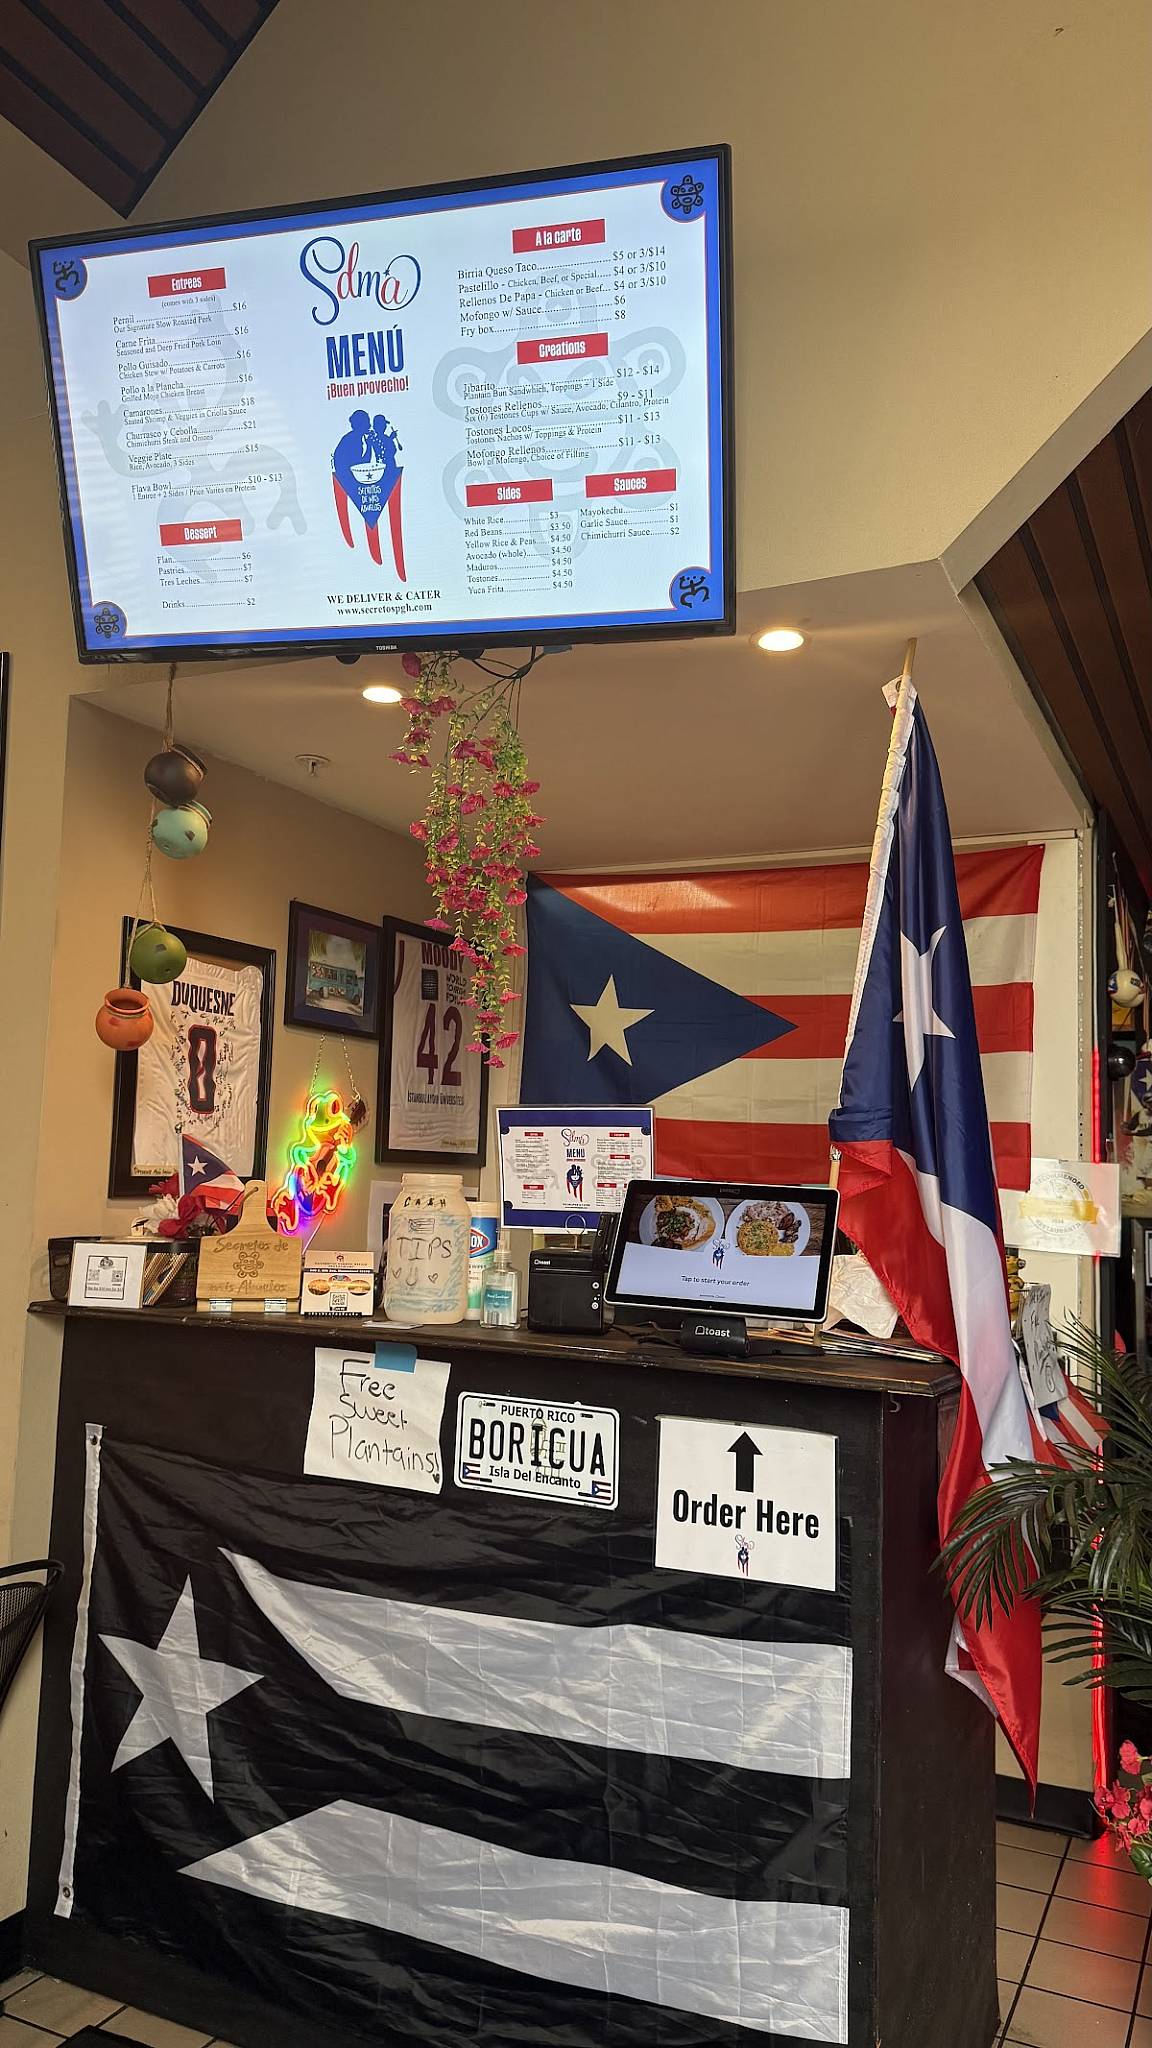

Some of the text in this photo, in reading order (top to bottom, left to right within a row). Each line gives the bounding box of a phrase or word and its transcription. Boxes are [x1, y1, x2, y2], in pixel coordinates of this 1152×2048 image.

[536, 228, 581, 246] A la carte
[458, 268, 483, 279] Birria
[485, 265, 513, 277] Queso
[516, 262, 537, 272] Taco
[613, 251, 624, 261] $5
[639, 246, 665, 258] 3/$14
[172, 276, 202, 291] Entrees
[458, 281, 498, 294] Pastelillo
[508, 277, 539, 288] Chicken,
[541, 275, 559, 285] Beef,
[571, 270, 597, 281] Special
[614, 266, 624, 276] $4
[640, 261, 666, 273] 3/$10
[459, 297, 497, 308] Rellenos
[499, 295, 512, 303] De
[514, 292, 536, 303] Papa
[545, 287, 574, 299] Chicken
[614, 281, 625, 290] $4
[640, 275, 667, 287] 3/$10
[113, 302, 247, 325] Pernil $16
[460, 295, 626, 322] Mofongo w/ Sauce $6
[461, 310, 626, 337] Fry box $8
[116, 326, 249, 349] Carne Frita $16
[326, 324, 404, 379] MENÚ
[539, 341, 585, 358] Creations
[119, 351, 251, 372] Pollo Guisado $16
[617, 366, 659, 378] $12 $14
[121, 374, 253, 395] Pollo la Plancha $16
[327, 375, 409, 400] ¡Buen provecho!
[123, 398, 255, 418] Camarones $18
[465, 404, 502, 415] Tostones
[504, 401, 542, 410] Rellenos
[617, 392, 628, 400] $9
[126, 421, 256, 441] Churrasco Cebolla $21
[465, 412, 660, 437] Tostones Locos $11 $13
[128, 453, 152, 464] Veggie
[154, 452, 172, 460] Plate
[467, 435, 660, 459] Mofongo Rellenos $11 $13
[132, 474, 282, 494] Flava Bowl $10 $13
[497, 477, 647, 500] Sides Sauces
[464, 517, 485, 525] White
[488, 516, 503, 524] Rice
[669, 503, 678, 511] $1
[184, 526, 218, 540] Dessert
[465, 515, 678, 537] Red Beans $3.50 Garlic Sauce $1
[465, 540, 489, 549] Yellow
[493, 538, 509, 546] Rice
[551, 534, 571, 542] $4.50
[581, 529, 625, 541] Chimichurri
[628, 528, 650, 537] Sauce
[670, 527, 680, 535] $2
[157, 552, 251, 564] Flan $6
[466, 545, 571, 560] Avocado (whole) $4.50
[158, 567, 184, 575] Pastries
[467, 557, 572, 572] Maduros $4.50
[160, 578, 174, 586] Tres
[176, 577, 200, 585] Leches
[467, 569, 572, 583] Tostones $4.50
[468, 586, 486, 594] Yuca
[553, 580, 572, 589] $4.50
[162, 598, 256, 609] Drinks $2
[328, 590, 441, 604] WE DELIVER & CATER
[338, 604, 432, 615] www.secretospgh.com
[171, 981, 236, 1016] DUQUESNE
[417, 1003, 462, 1086] 42
[274, 1240, 288, 1252] de
[396, 1237, 452, 1261] TIPS
[705, 1327, 731, 1338] toast
[340, 1359, 395, 1400] Free
[340, 1394, 407, 1430] Sweet
[501, 1405, 575, 1423] PUERTO RICO
[329, 1415, 440, 1474] Plantains!
[469, 1418, 605, 1476] BORICUA
[489, 1466, 580, 1489] Isla Del Encanto
[673, 1489, 819, 1538] Order Here
